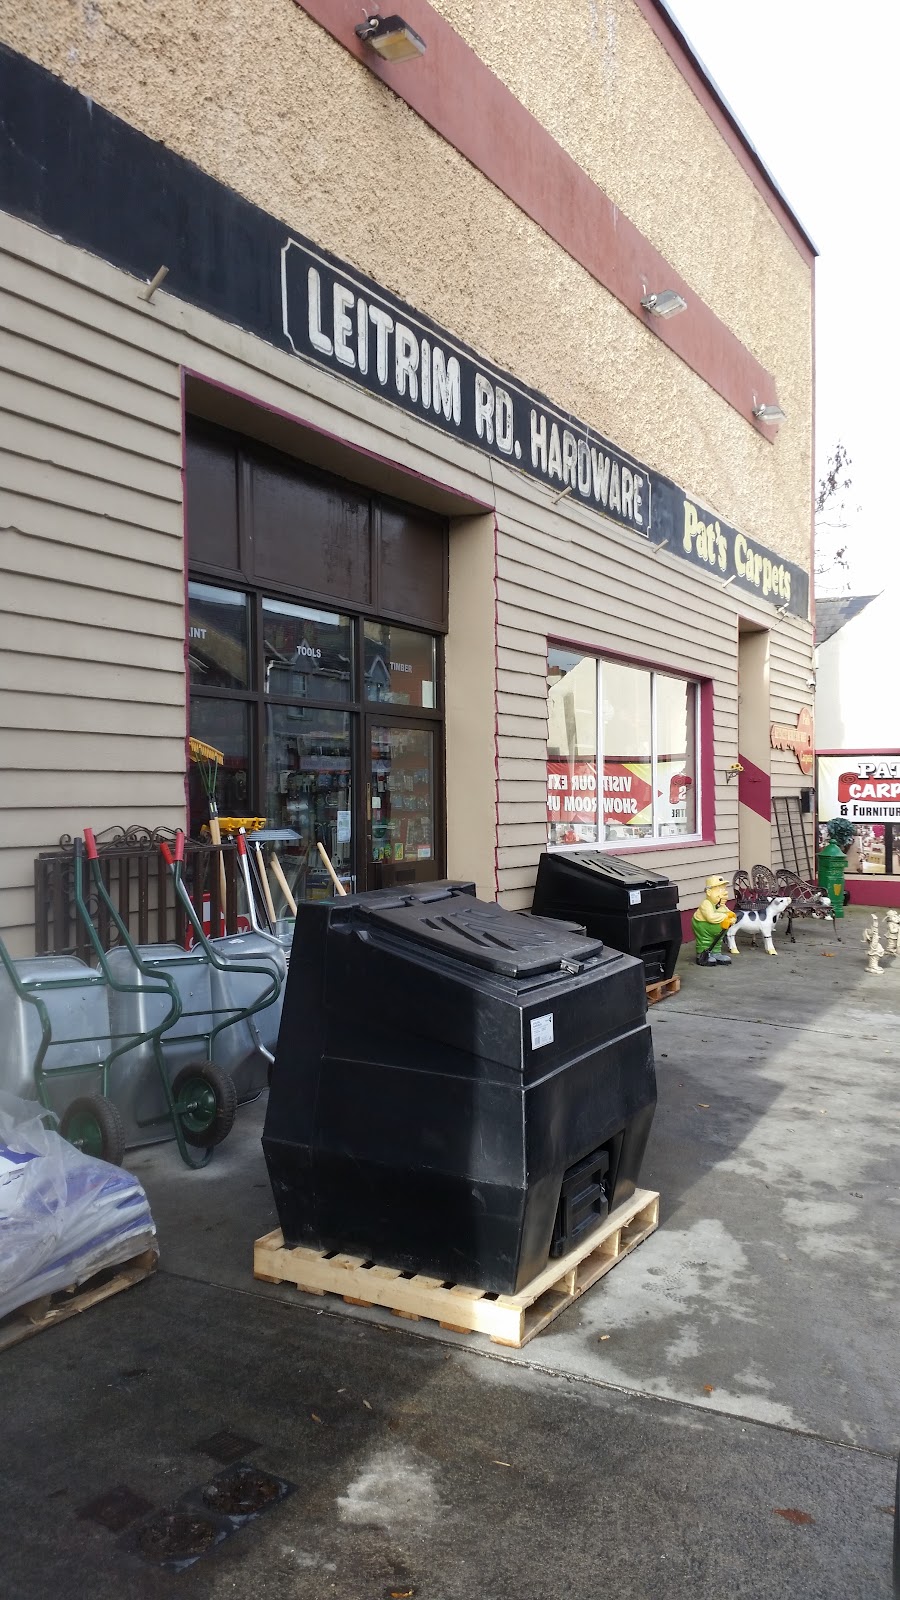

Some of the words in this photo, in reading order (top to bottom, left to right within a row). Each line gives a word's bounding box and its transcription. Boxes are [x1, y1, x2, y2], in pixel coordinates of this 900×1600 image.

[308, 267, 461, 426] LEITRIM
[475, 373, 522, 460] RD.
[530, 409, 644, 526] HARDWARE
[683, 500, 728, 573] Pat's
[734, 533, 792, 601] Carpets
[188, 626, 207, 640] INT
[296, 645, 321, 659] TOOLS
[389, 661, 413, 674] TIMBER
[840, 804, 849, 816] &
